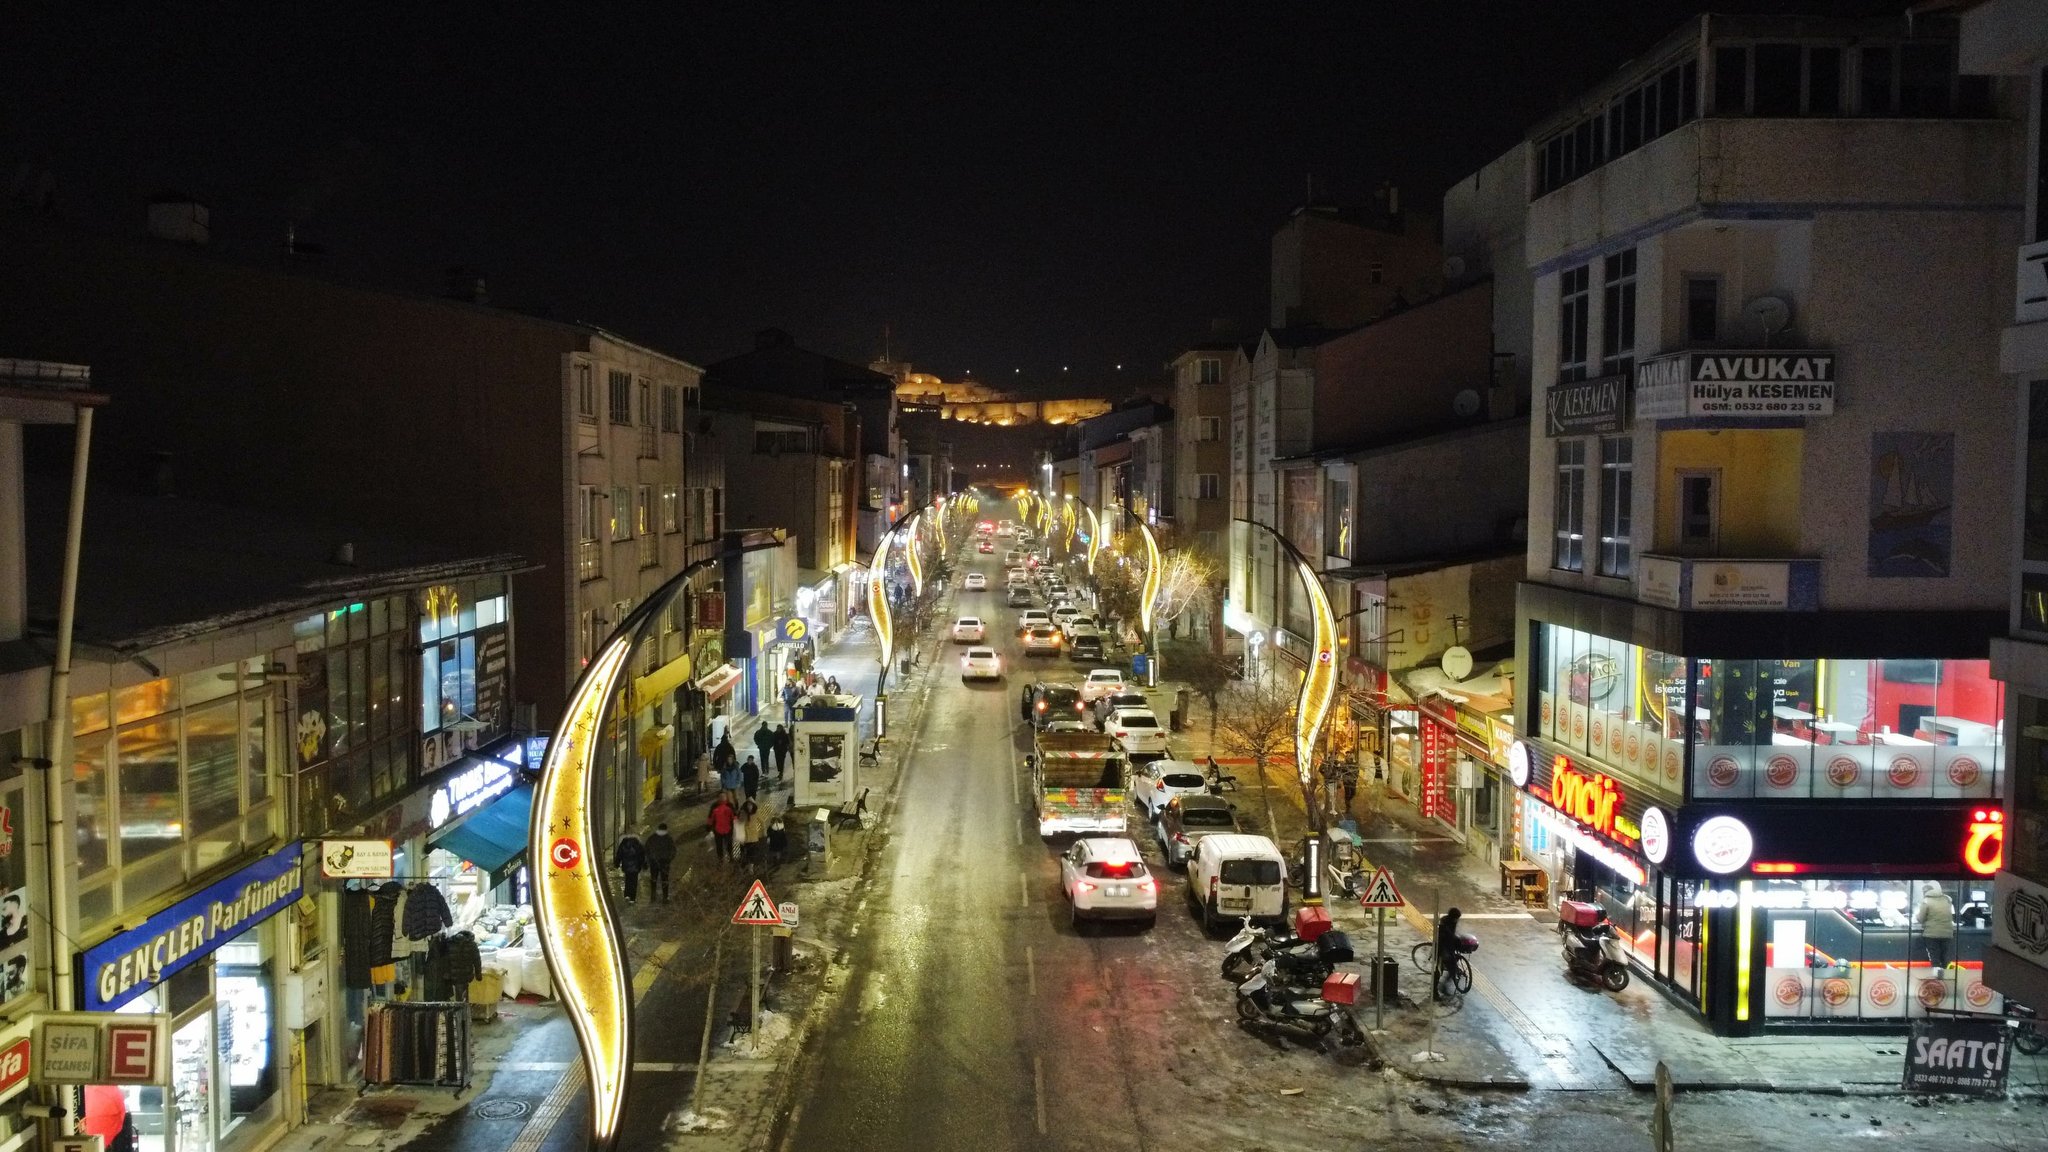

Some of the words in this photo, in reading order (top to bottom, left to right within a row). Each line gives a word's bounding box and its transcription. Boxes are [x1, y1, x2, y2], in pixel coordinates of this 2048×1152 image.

[1639, 360, 1685, 387] AVUKAT
[1697, 357, 1831, 380] AVUKAT
[1563, 381, 1620, 417] KESEMEN
[1694, 384, 1743, 401] Hülya
[1748, 384, 1832, 398] KESEMEN
[1703, 403, 1732, 411] GSM:
[1735, 403, 1763, 411] 0532
[1766, 403, 1788, 411] 680
[1790, 403, 1806, 411] 23
[1808, 403, 1822, 411] 52
[97, 916, 206, 1005] GENÇLER
[209, 866, 303, 940] Parfümeri
[50, 1033, 88, 1054] ŞİFA
[115, 1032, 148, 1075] E
[1914, 1036, 2006, 1078] SAATÇİ
